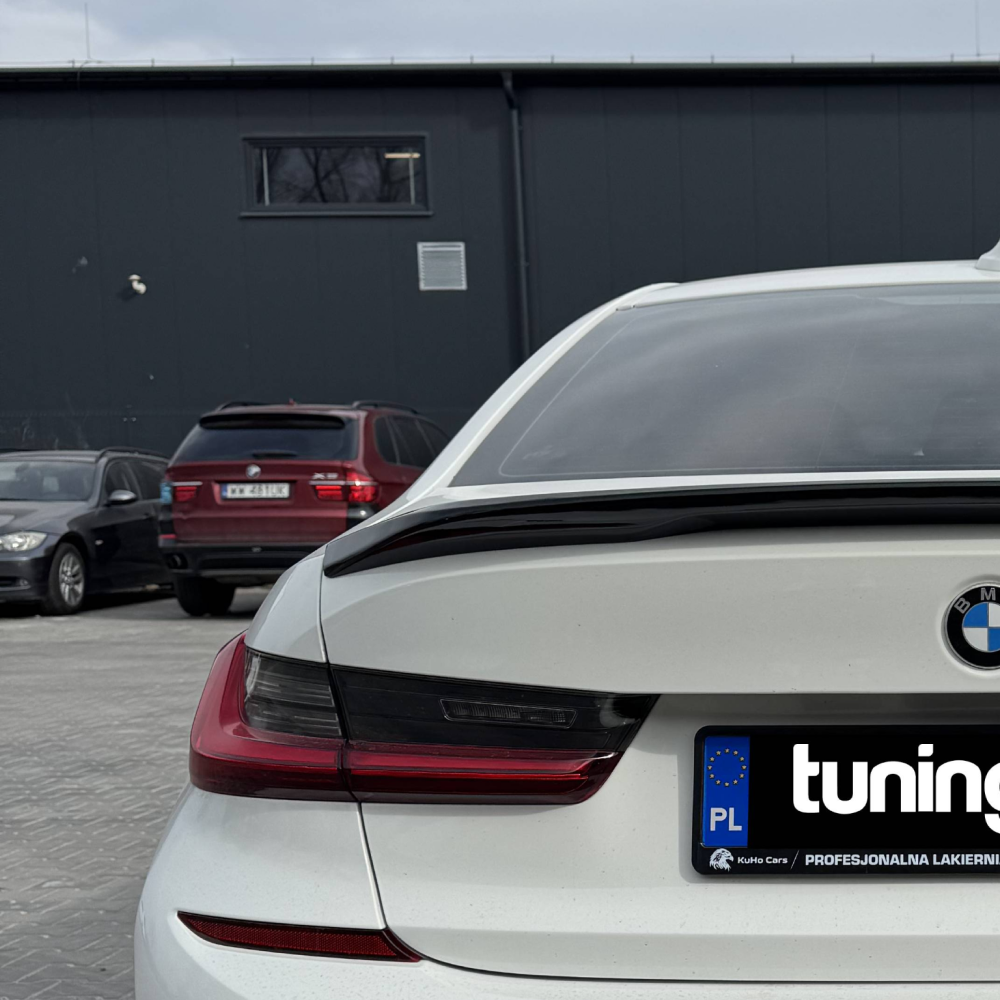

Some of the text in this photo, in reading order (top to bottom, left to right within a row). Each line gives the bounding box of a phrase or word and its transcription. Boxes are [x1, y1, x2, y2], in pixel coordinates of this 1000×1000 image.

[710, 807, 743, 832] PL
[737, 856, 788, 864] KuHo Cars
[805, 853, 930, 866] PROFESJONALNA
